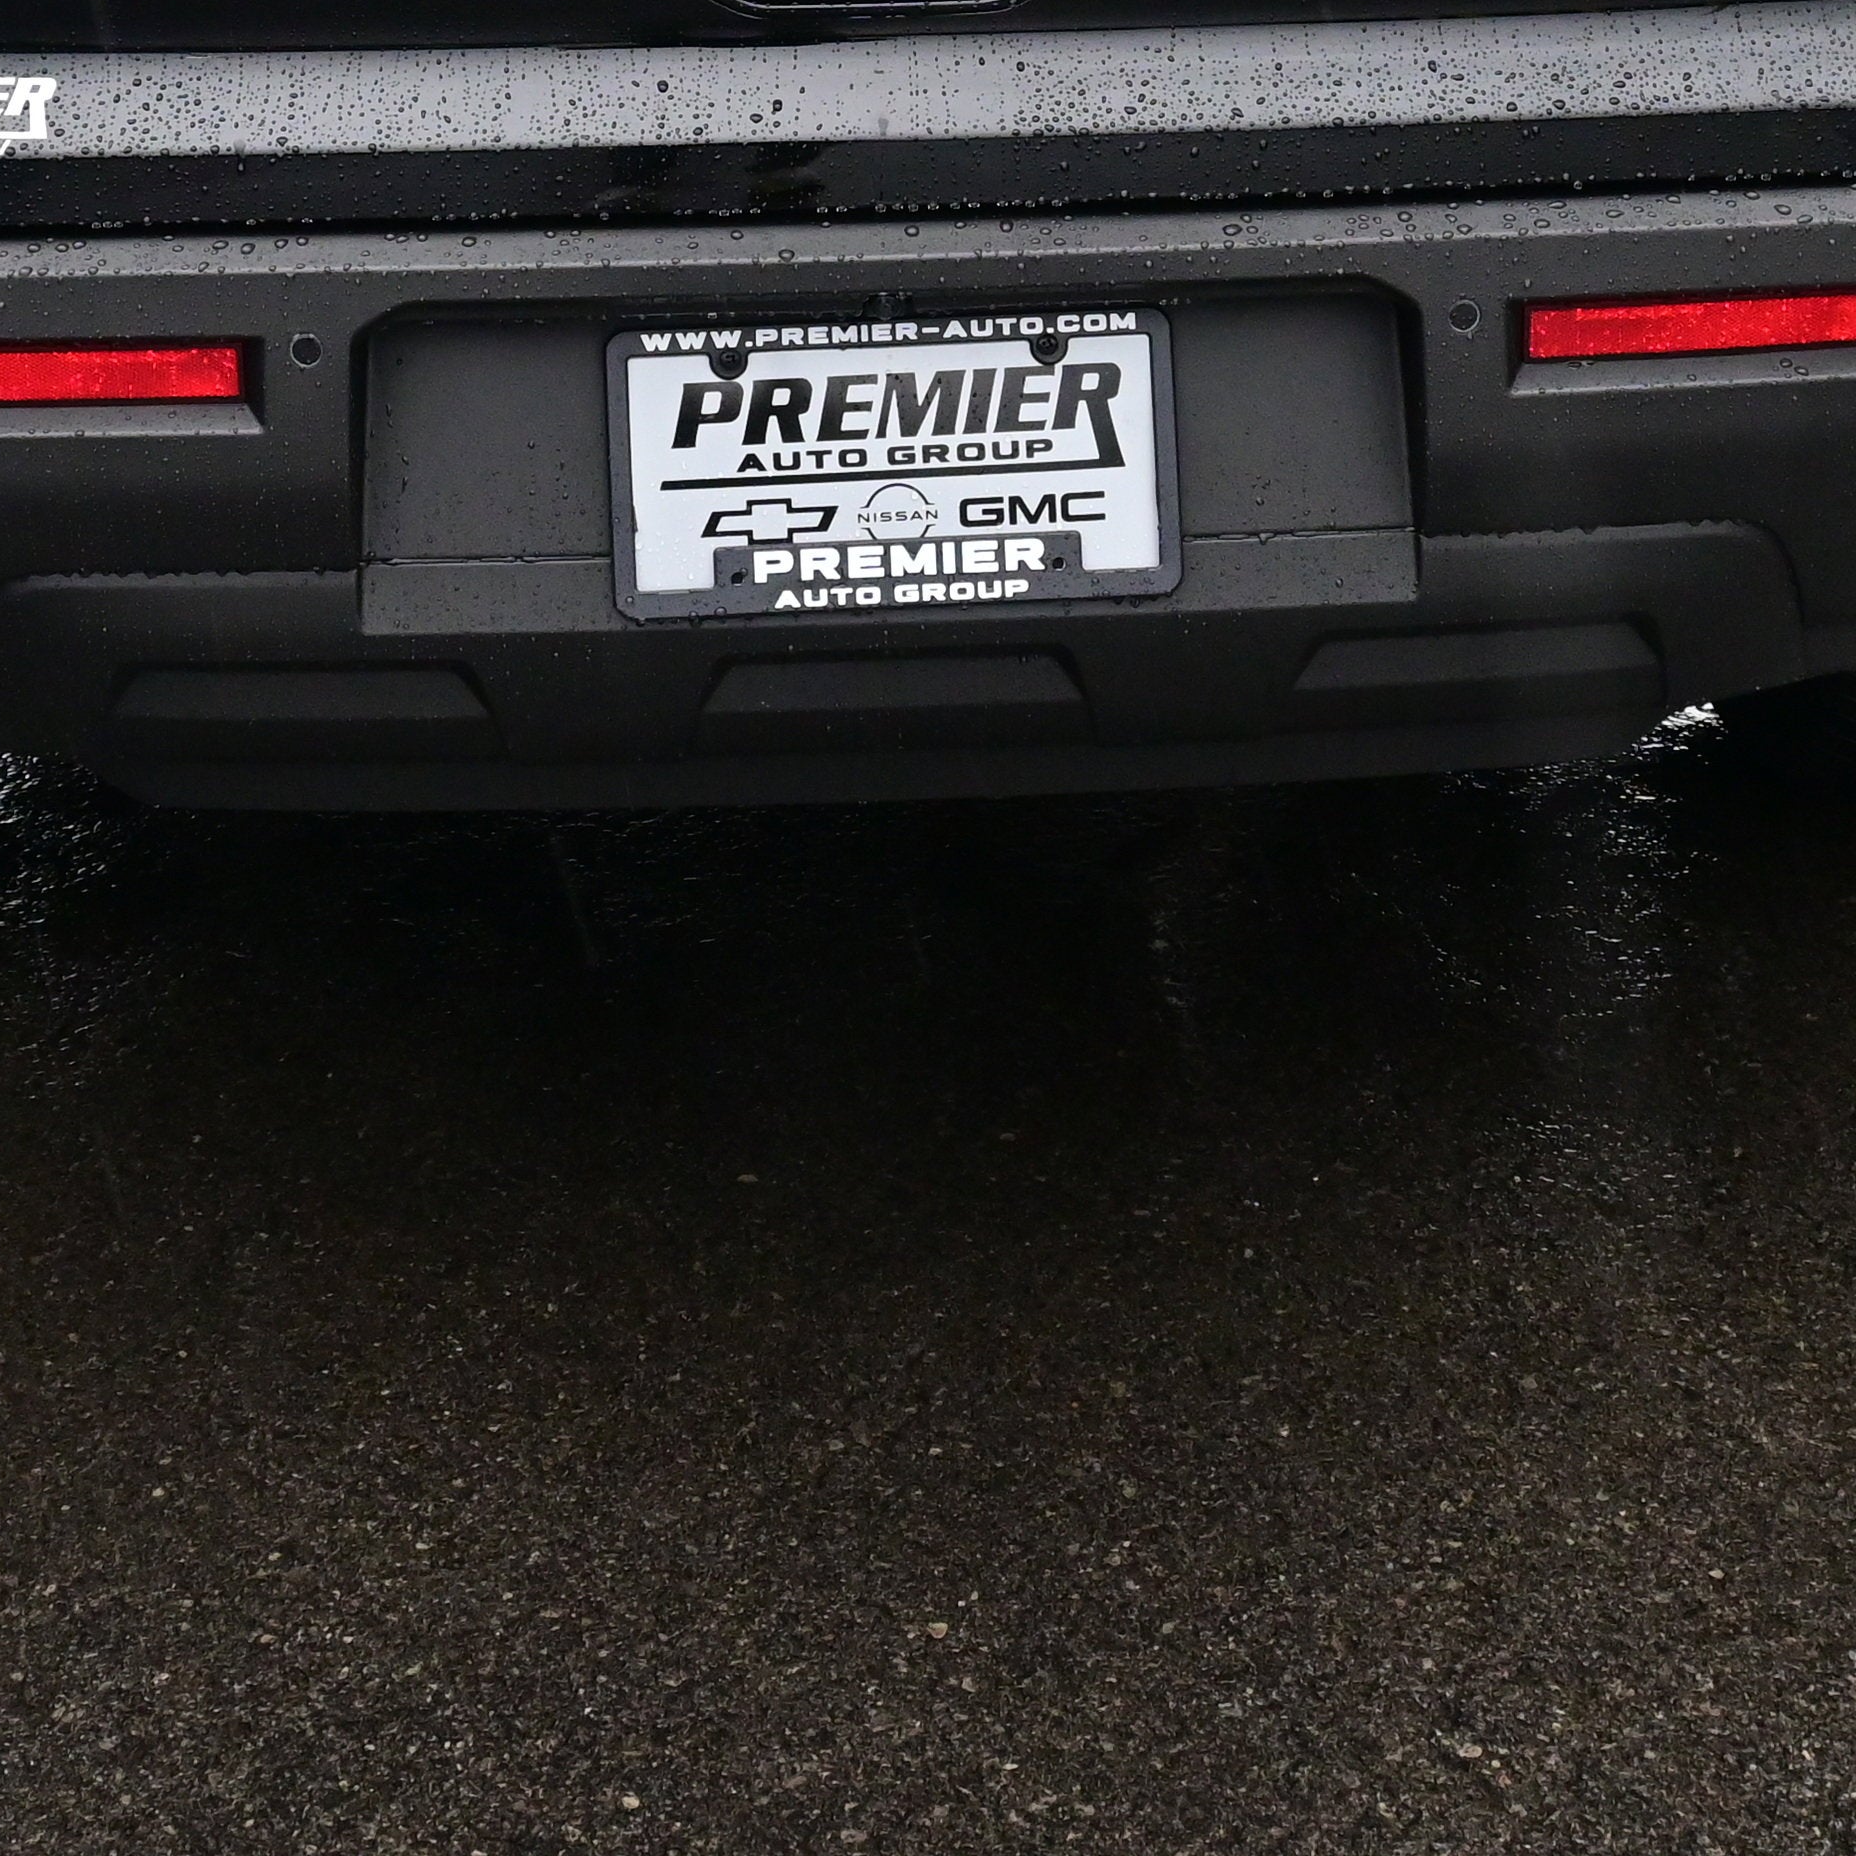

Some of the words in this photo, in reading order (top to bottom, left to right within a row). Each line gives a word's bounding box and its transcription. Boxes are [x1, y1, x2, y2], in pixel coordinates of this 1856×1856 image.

[640, 311, 1138, 352] WWW.PREMIER-AUTO.COM
[671, 361, 1125, 467] PREMIER
[736, 448, 869, 473] AUTO
[886, 438, 1054, 463] GROUP
[857, 507, 939, 523] NISSAN
[958, 490, 1106, 528] GMC
[752, 538, 1046, 584] PREMIER
[773, 584, 882, 610] AUTO
[893, 578, 1030, 602] GROUP
